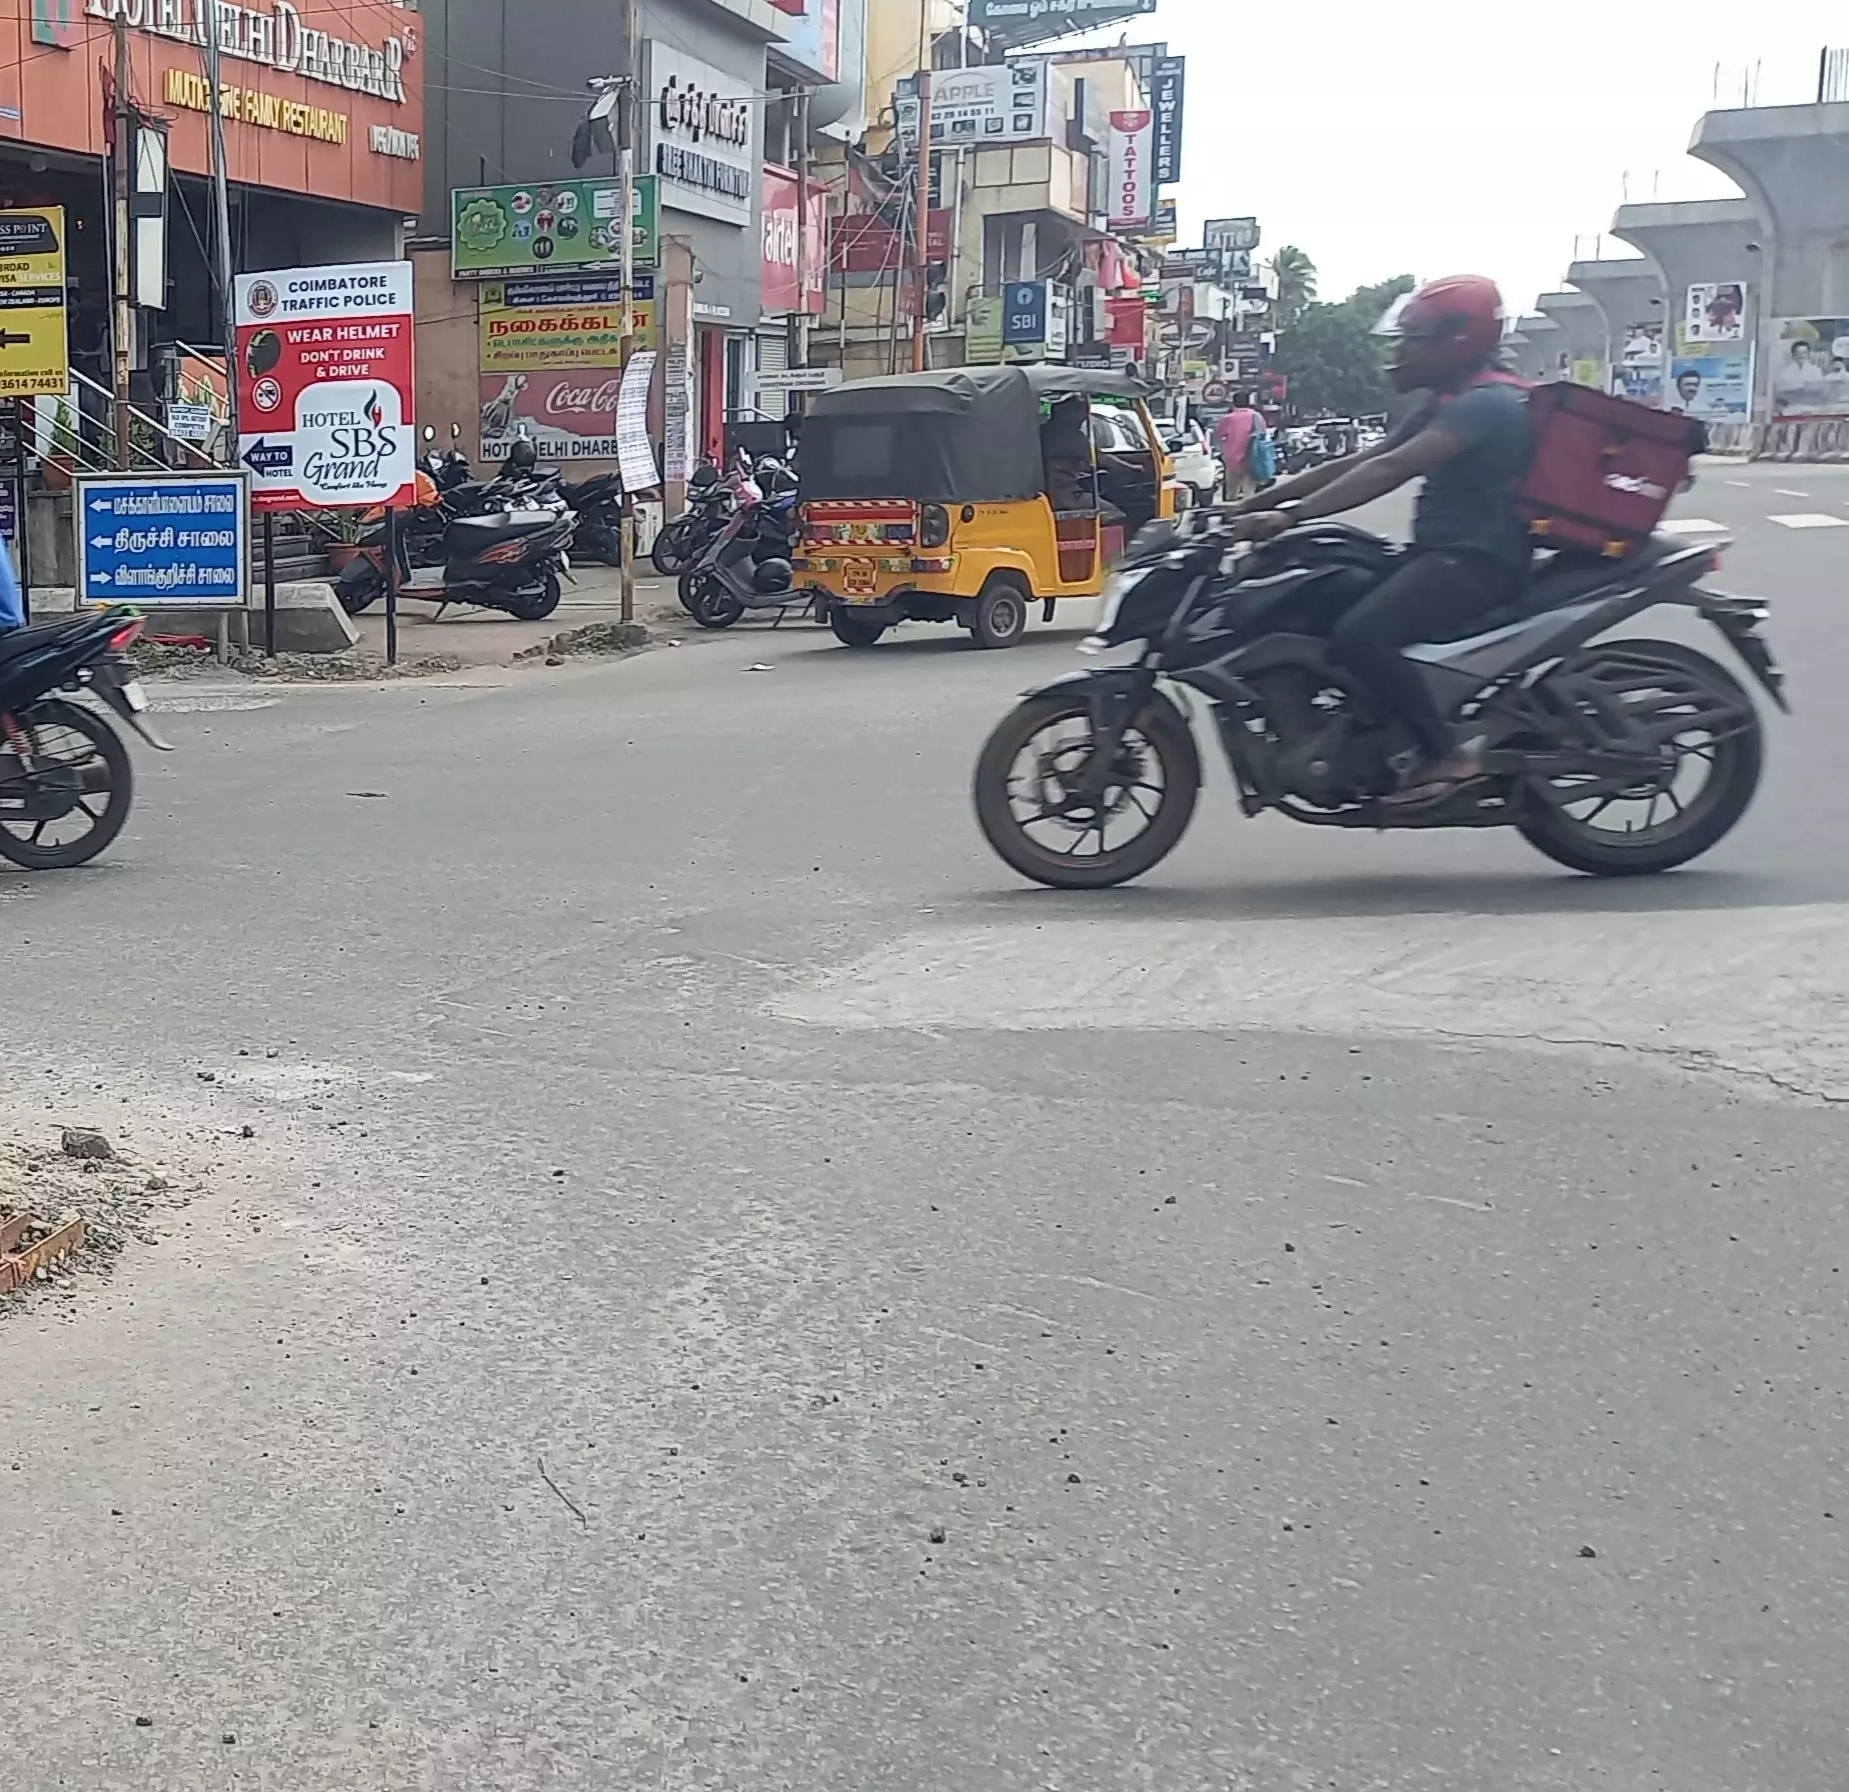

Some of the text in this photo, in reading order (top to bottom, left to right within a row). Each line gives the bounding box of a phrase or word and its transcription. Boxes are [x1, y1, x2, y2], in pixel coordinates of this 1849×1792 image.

[933, 81, 995, 103] APPLE
[283, 100, 347, 144] RESTAURANT
[1157, 79, 1176, 179] JEWELLERS
[1122, 134, 1138, 217] TATTOOS
[13, 223, 47, 234] POINT
[288, 276, 387, 293] COIMBATORE
[281, 293, 396, 311] TRAFFIC POLICE
[1011, 314, 1036, 330] SBI
[287, 324, 399, 343] WEAR HELMET
[301, 348, 384, 363] DON'T DRINK
[316, 364, 369, 377] & DRIVE
[30, 378, 63, 388] 74431
[302, 412, 361, 427] HOTEL
[330, 426, 396, 458] SBS
[482, 443, 510, 458] HOT
[538, 441, 568, 456] ELHI
[251, 452, 288, 462] WAY TO
[303, 445, 385, 485] Grand
[266, 469, 293, 477] HOTEL
[114, 527, 234, 554] திருச்சி சாலை
[198, 567, 234, 584] சாலை
